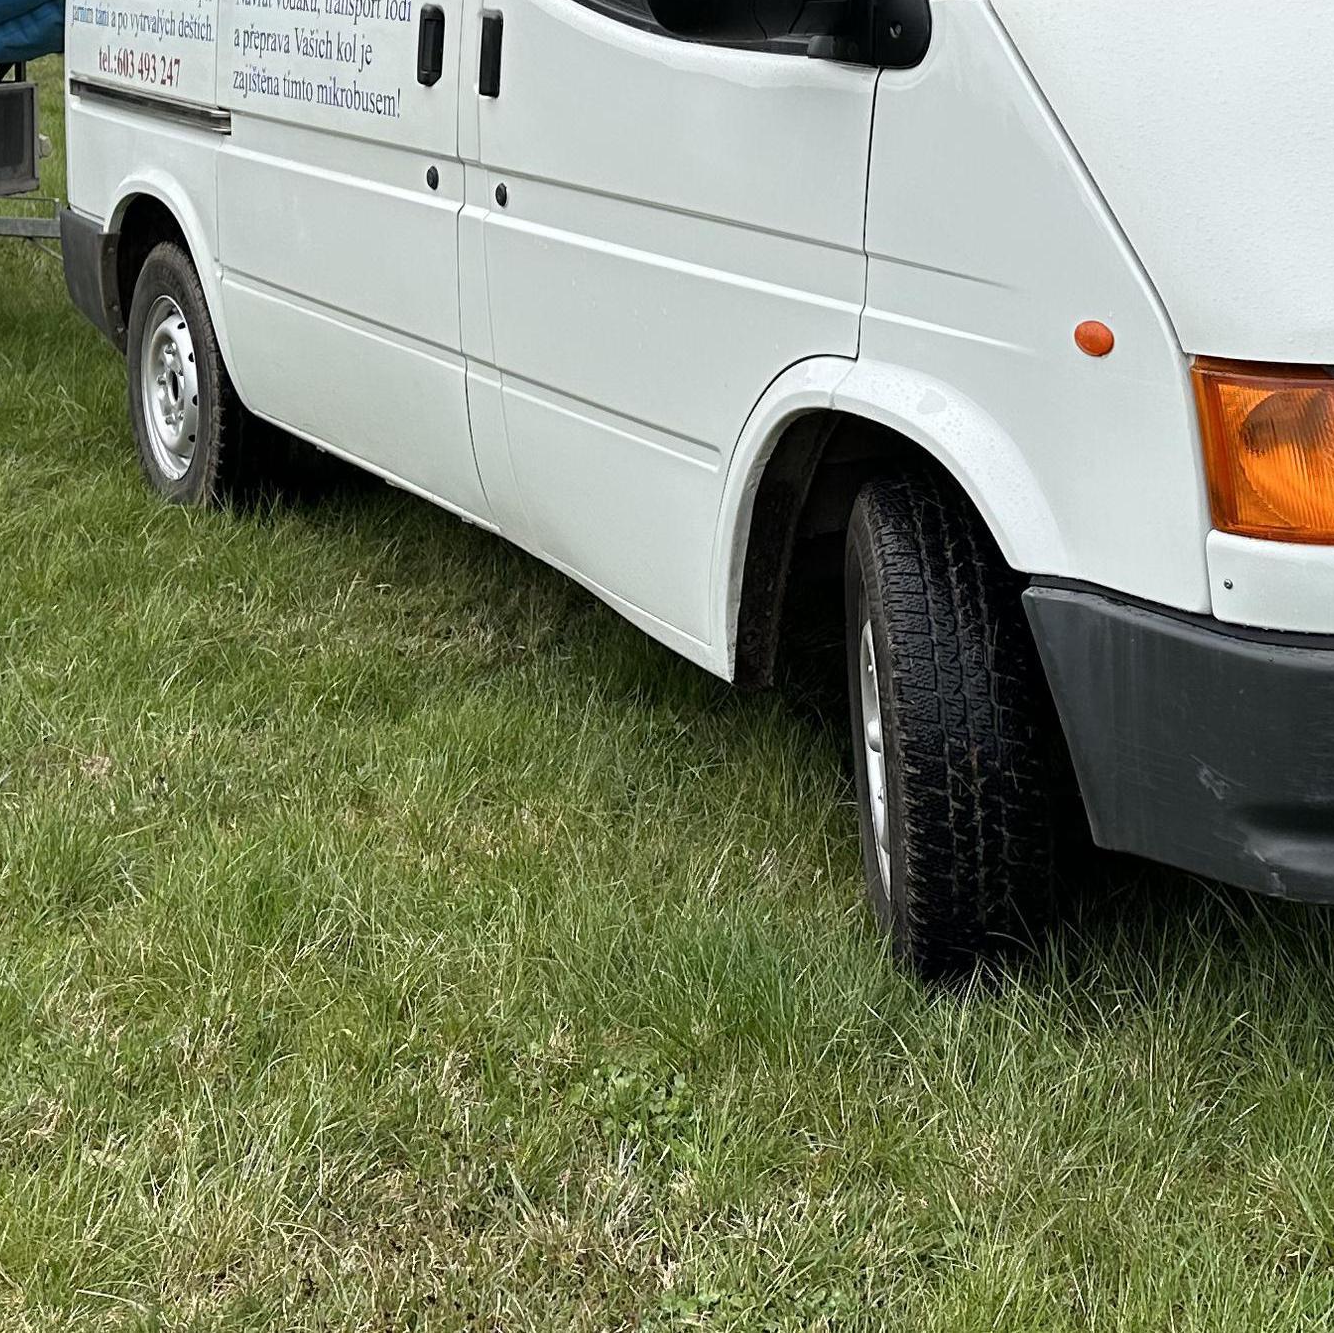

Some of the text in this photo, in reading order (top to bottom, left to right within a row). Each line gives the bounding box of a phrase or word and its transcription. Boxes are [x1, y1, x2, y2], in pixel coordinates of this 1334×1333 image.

[111, 10, 116, 28] a
[117, 12, 128, 36] po
[130, 8, 175, 41] vytrvalých
[178, 13, 215, 42] deštích.
[234, 23, 373, 73] a přeprava Vašich kol je
[99, 45, 181, 88] tel.:603 493 247
[233, 64, 401, 119] zajištěna tímto mikrobusem!
